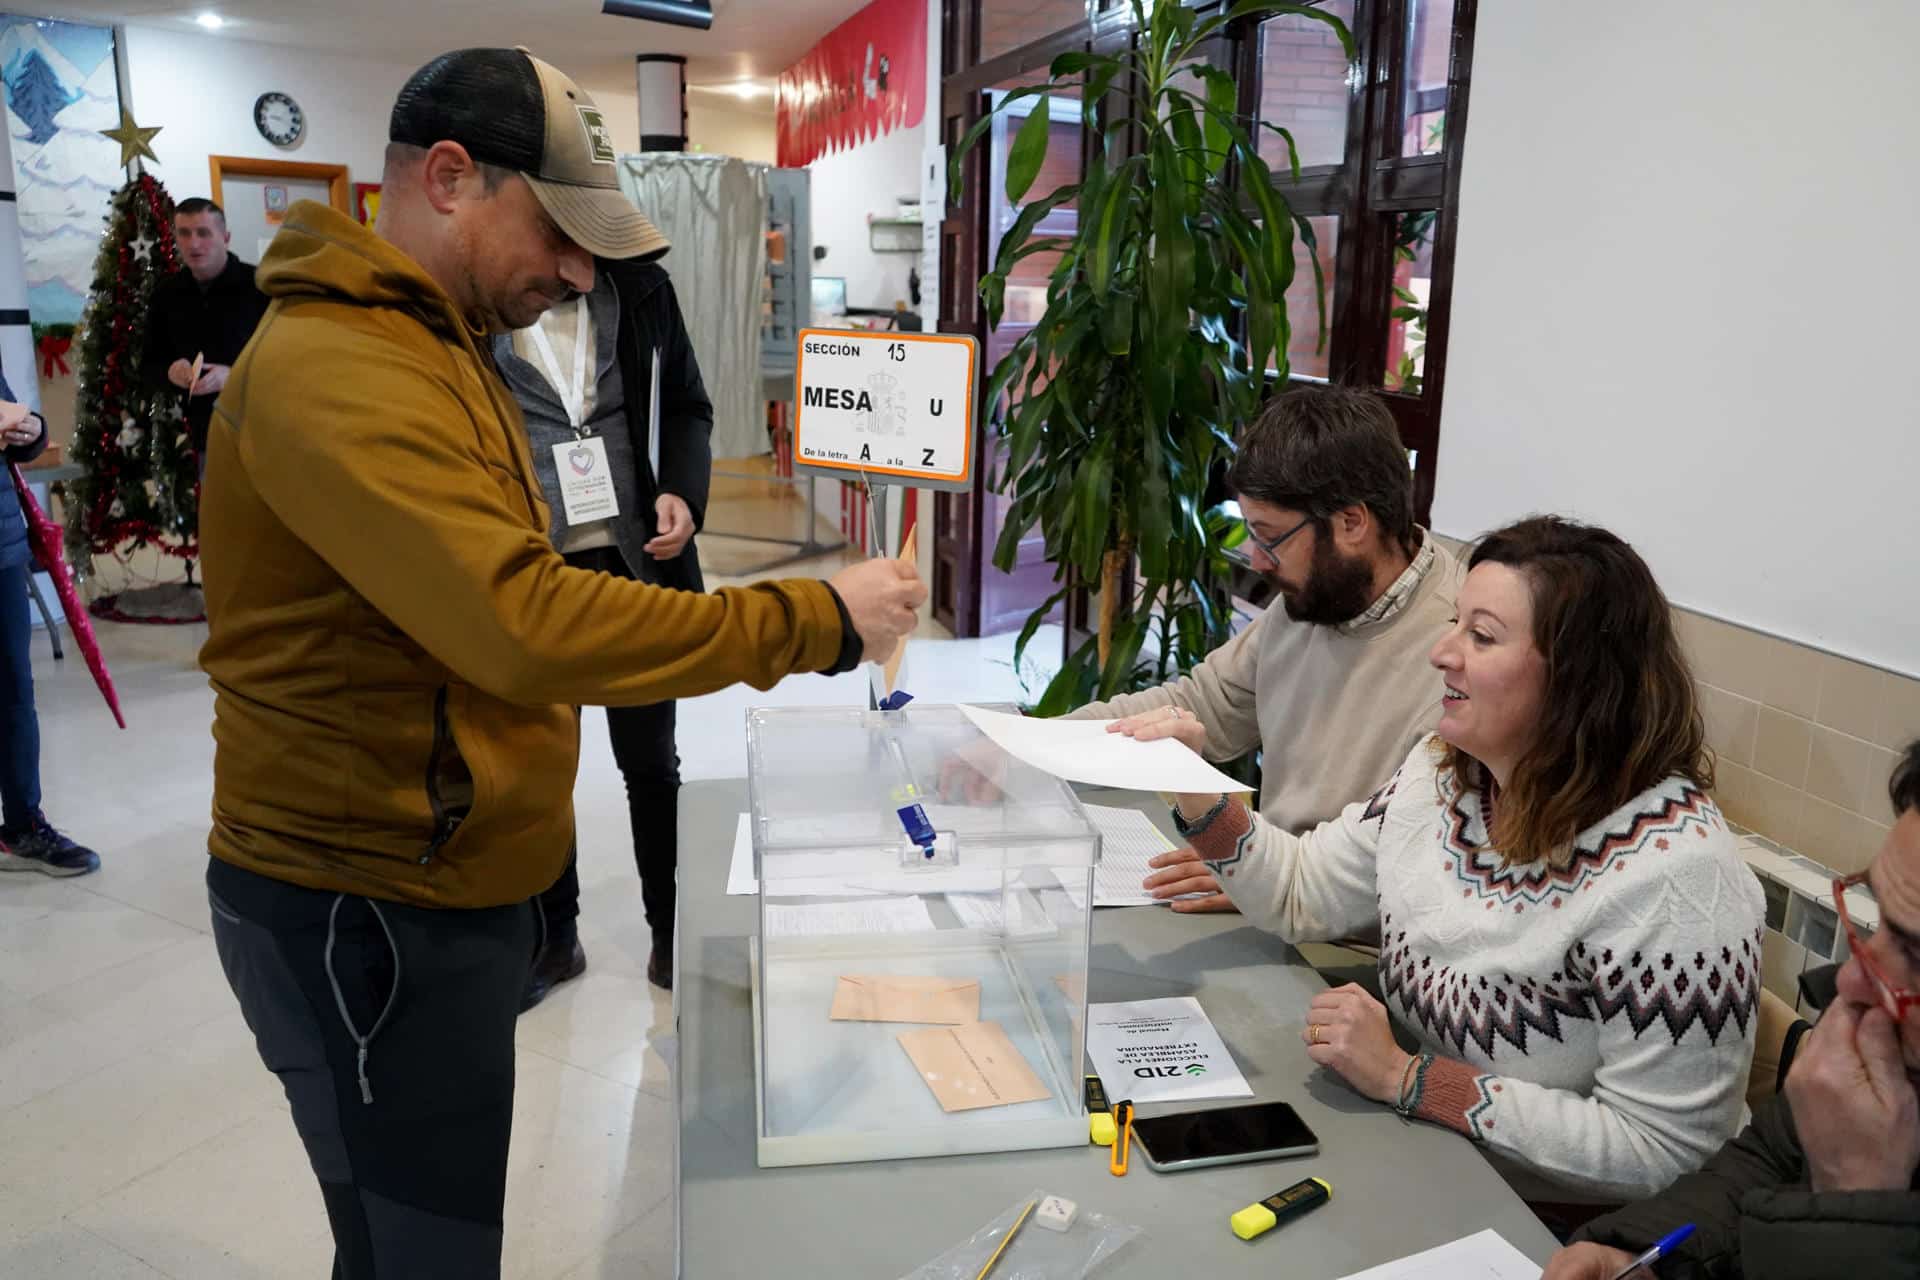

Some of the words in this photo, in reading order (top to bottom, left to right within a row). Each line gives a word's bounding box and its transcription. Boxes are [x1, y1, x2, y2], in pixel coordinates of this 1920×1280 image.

[805, 342, 860, 357] SECCIÓN
[888, 343, 906, 362] 15
[804, 386, 873, 412] MESA
[930, 398, 943, 417] U
[804, 447, 815, 456] De
[818, 449, 826, 457] la
[828, 450, 849, 460] letra
[860, 443, 871, 461] A
[895, 457, 904, 466] la
[921, 448, 935, 467] Z
[1116, 1042, 1198, 1052] EXTREMADURA
[1140, 1049, 1197, 1057] ASAMBLEA
[1145, 1054, 1209, 1063] ELECCIONES
[1134, 1065, 1182, 1078] 21D
